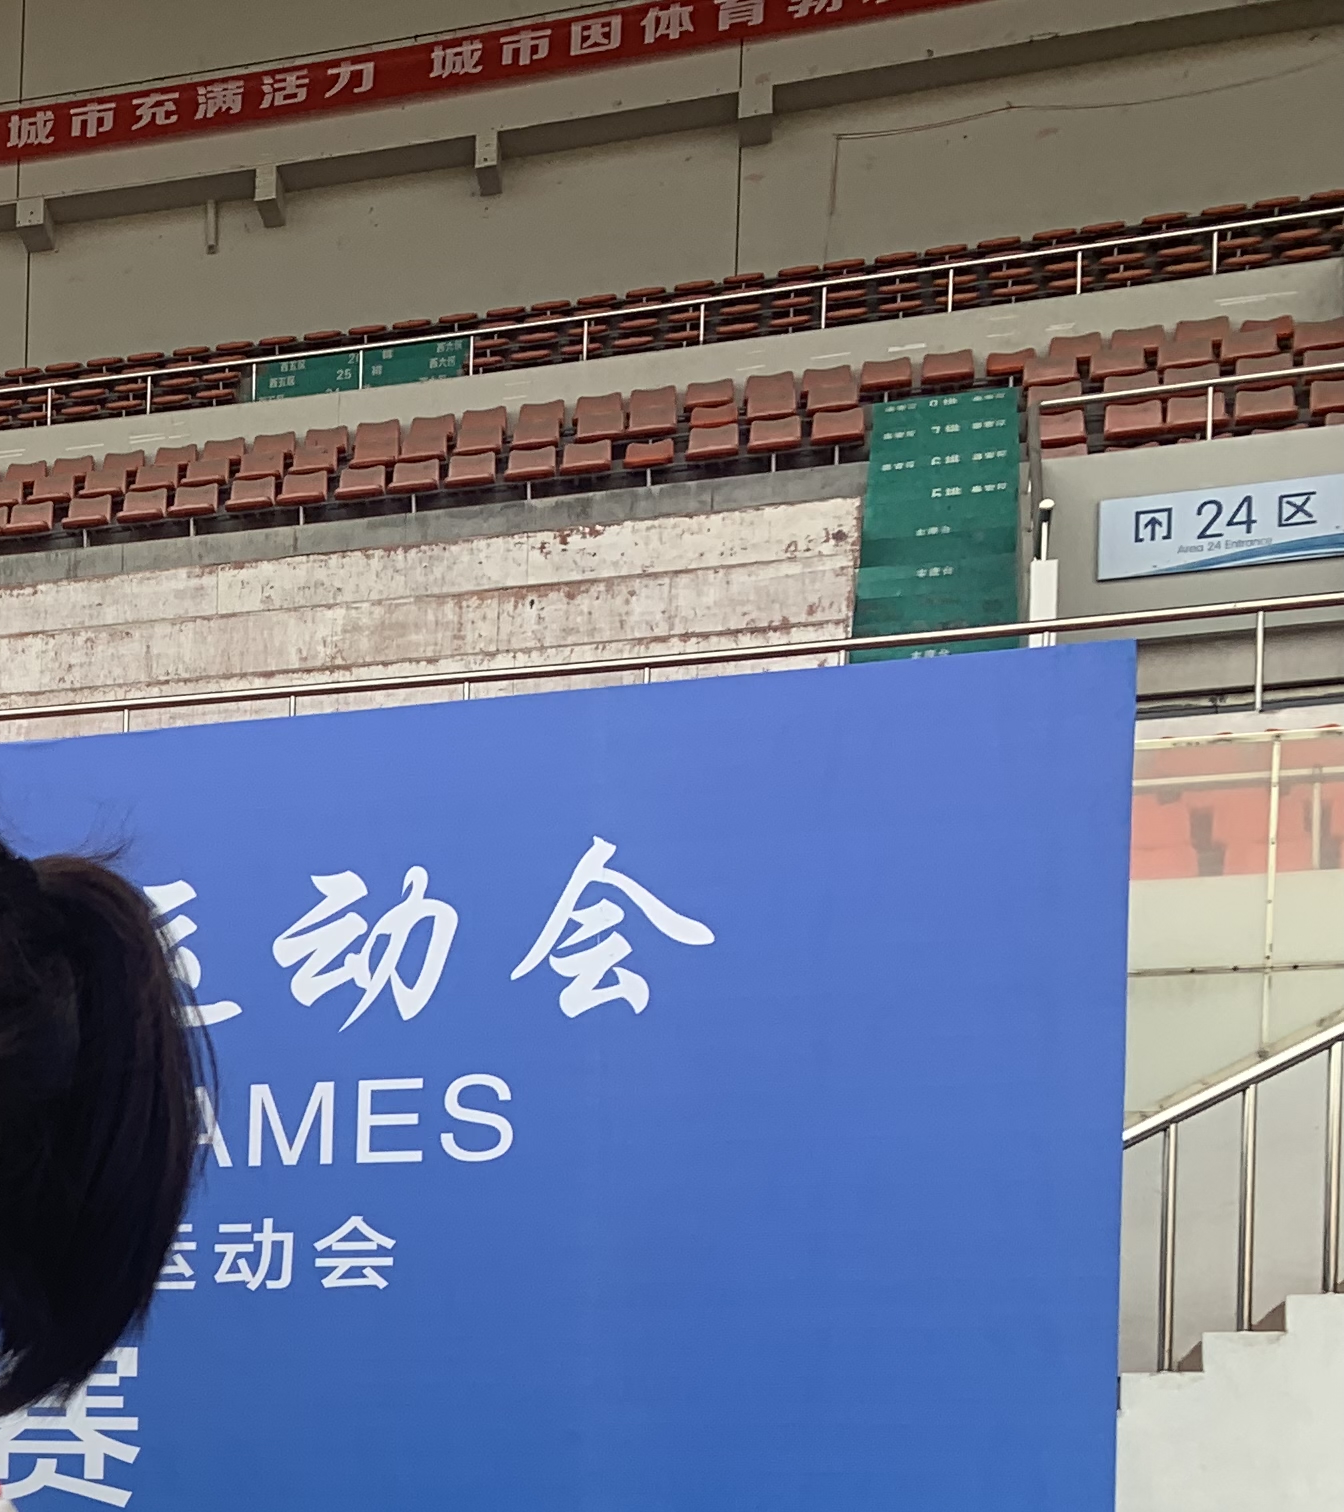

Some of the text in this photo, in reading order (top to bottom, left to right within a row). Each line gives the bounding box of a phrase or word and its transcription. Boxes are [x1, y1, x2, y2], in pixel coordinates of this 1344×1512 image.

[428, 0, 890, 81] 城市因体育
[1196, 491, 1317, 540] 24 区
[1177, 543, 1204, 555] Area
[1207, 540, 1222, 552] 24
